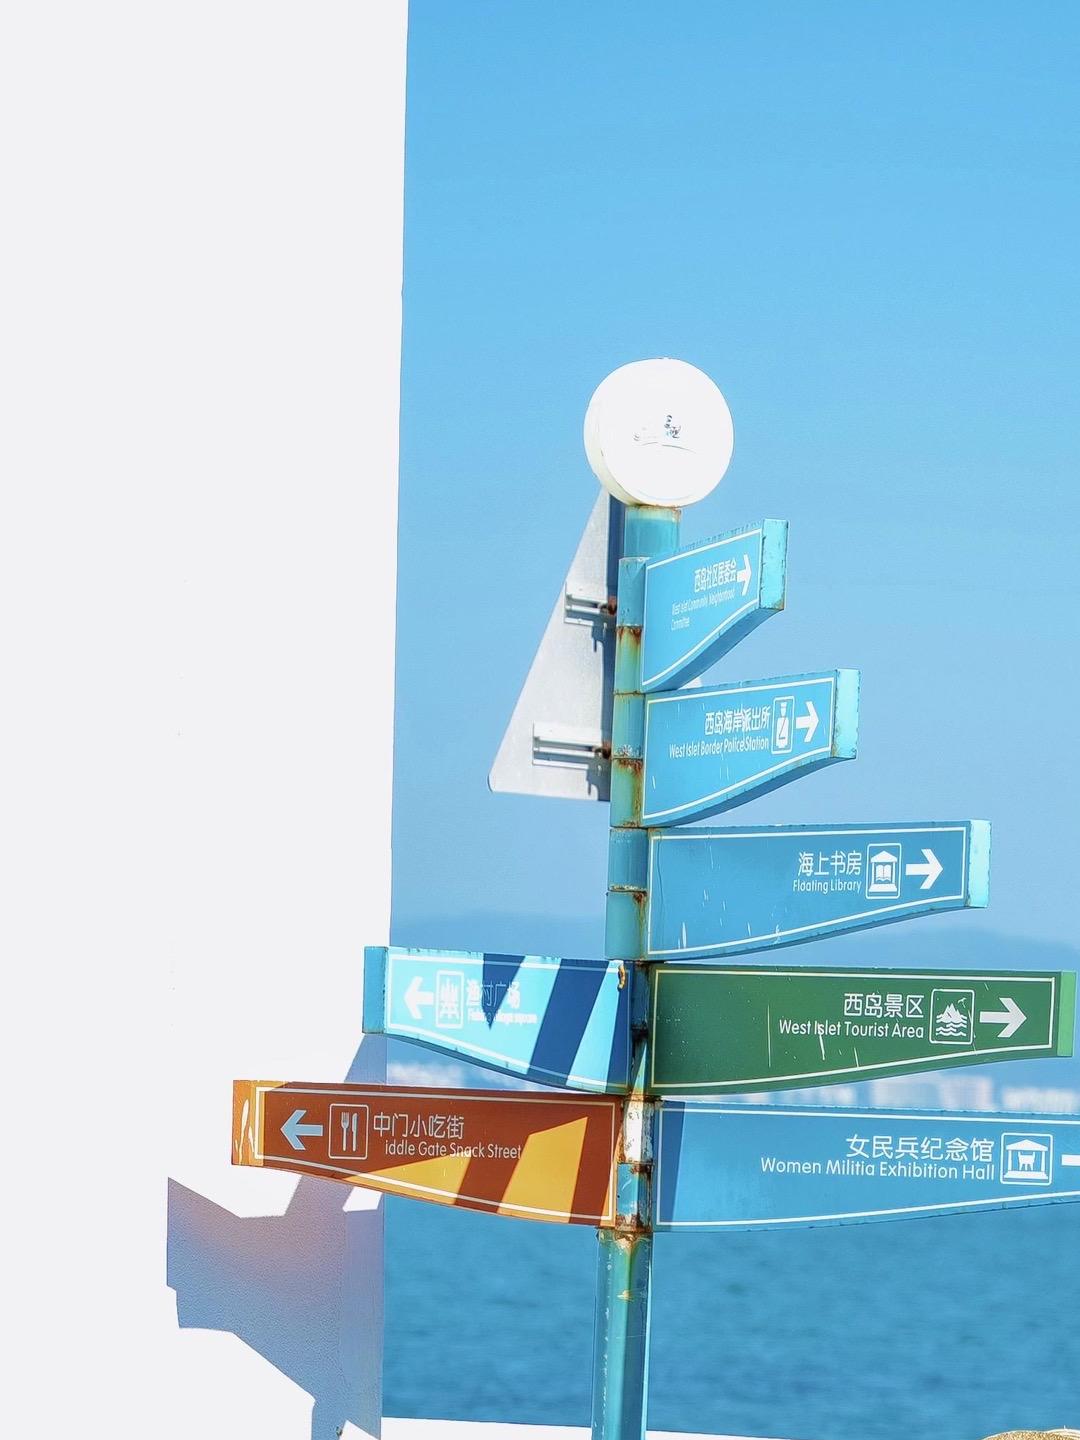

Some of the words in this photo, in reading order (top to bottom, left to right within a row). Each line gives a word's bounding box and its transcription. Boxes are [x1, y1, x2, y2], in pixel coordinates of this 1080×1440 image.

[669, 743, 685, 758] West
[700, 740, 723, 757] Border
[798, 850, 862, 877] 海上书房
[793, 878, 829, 895] Floating
[830, 878, 862, 894] Library
[844, 992, 925, 1019] 西岛景区
[779, 1019, 812, 1035] West
[814, 1020, 842, 1036] Islet
[844, 1021, 889, 1037] Tourist
[891, 1022, 924, 1039] Area
[373, 1111, 465, 1140] 中门小吃街
[418, 1141, 447, 1157] Gate
[449, 1141, 485, 1158] Snack
[487, 1143, 522, 1159] Street
[845, 1134, 995, 1163] 女民兵纪念馆
[760, 1157, 822, 1175] Women
[825, 1159, 875, 1177] Militia
[879, 1161, 958, 1180] Exhibition
[962, 1164, 995, 1181] Hall
